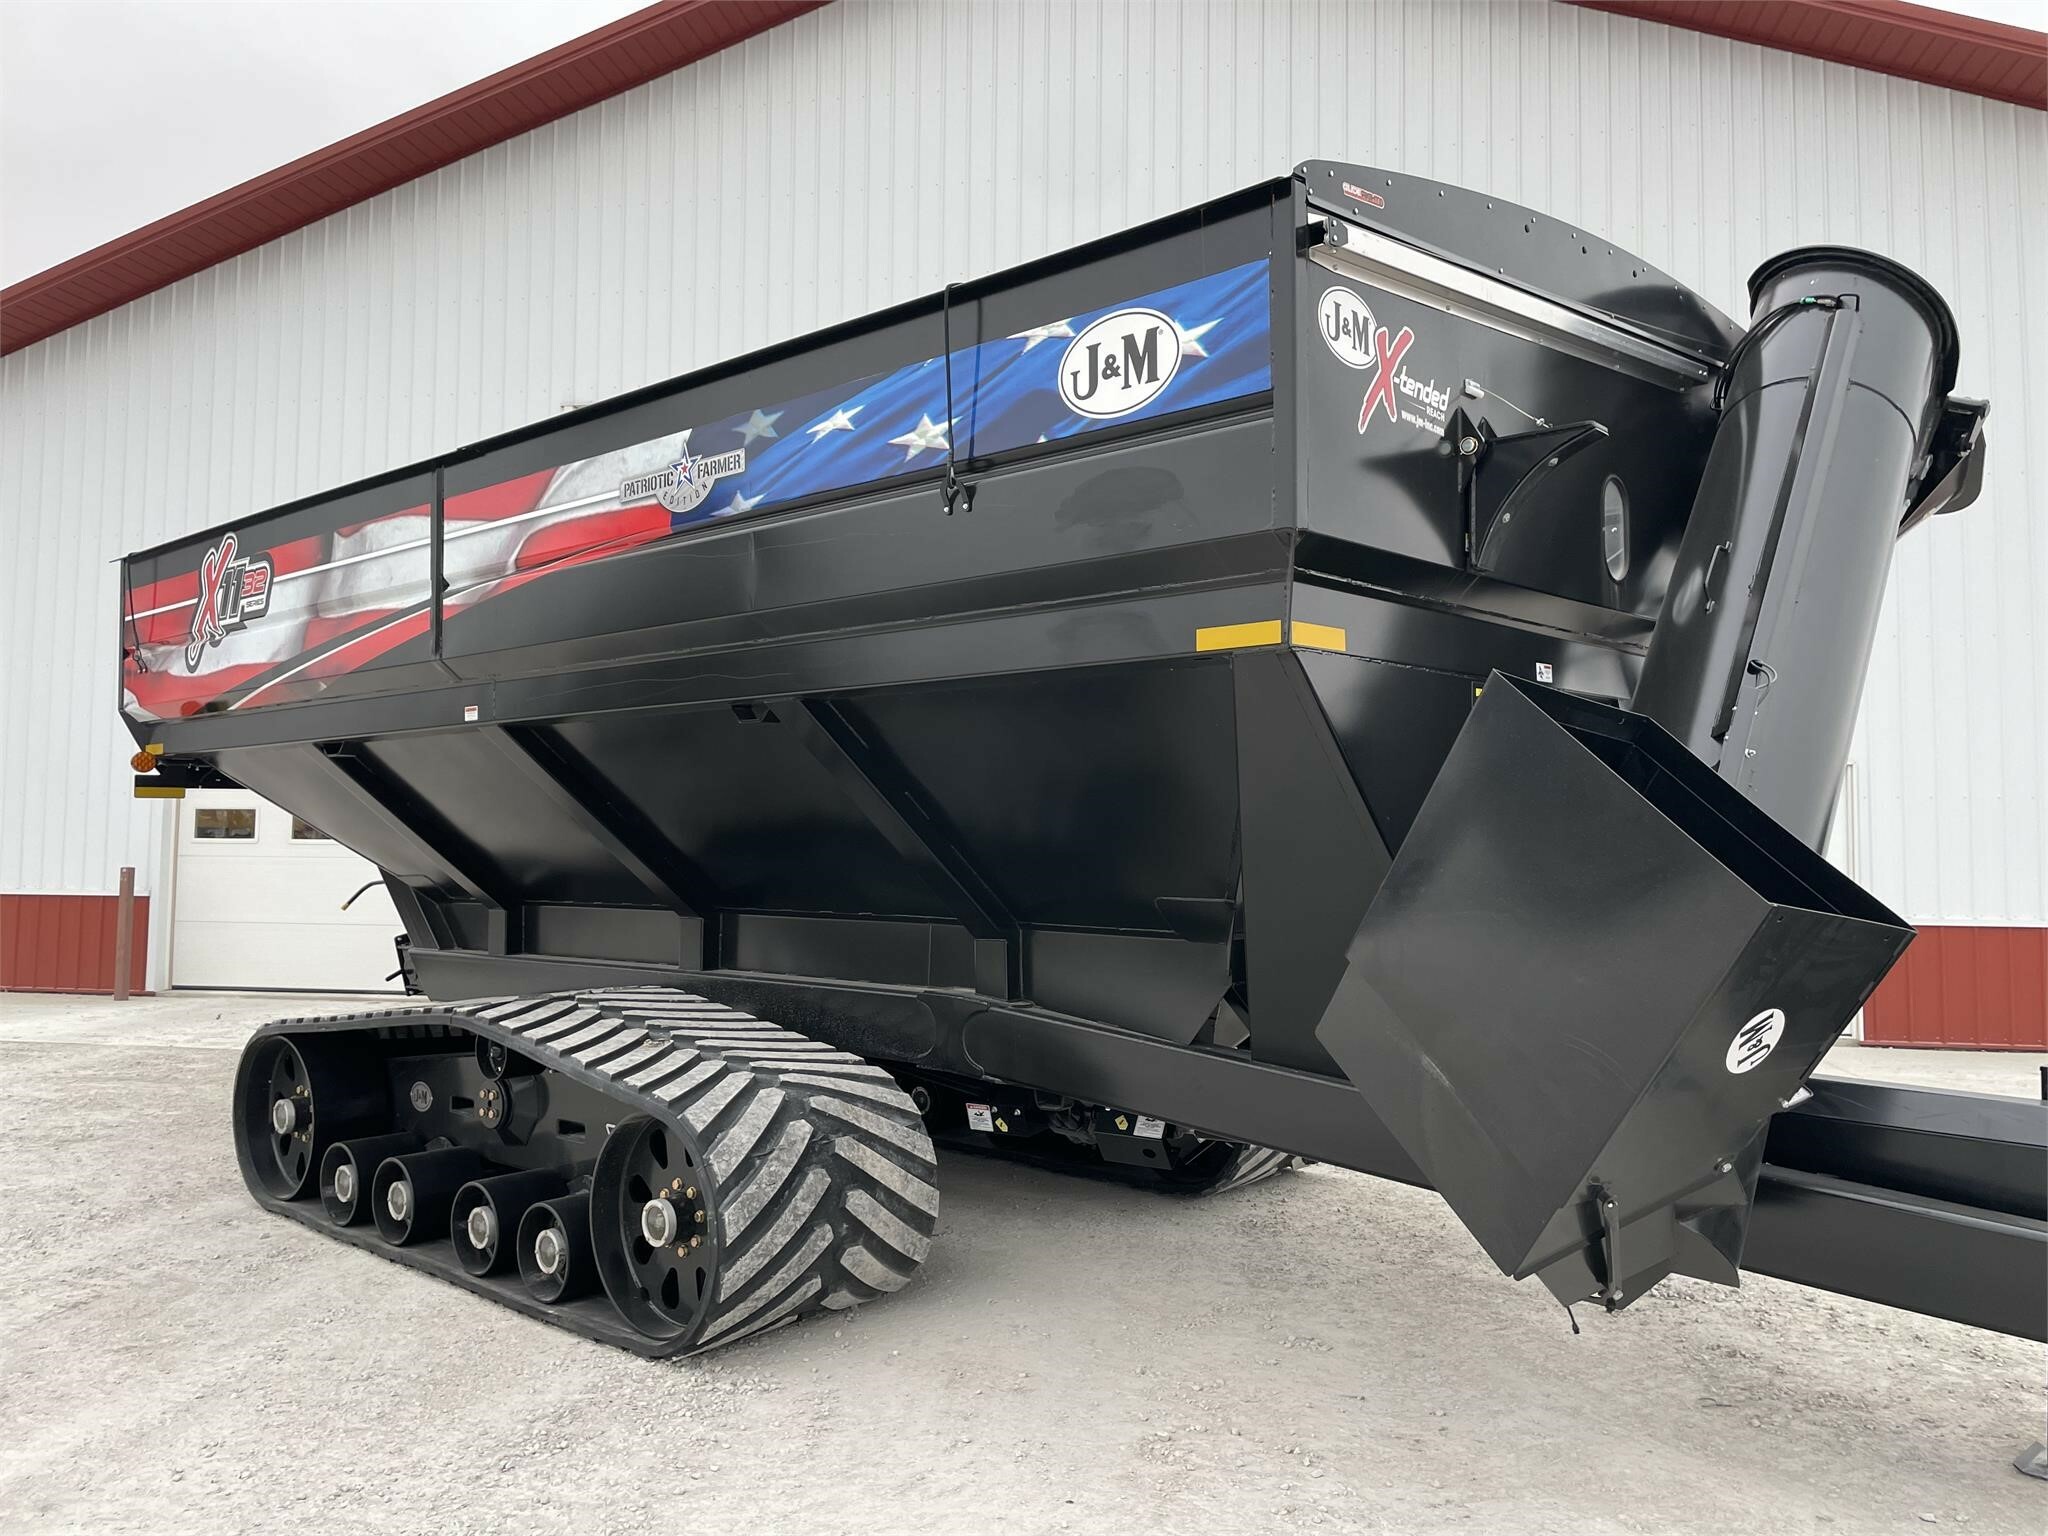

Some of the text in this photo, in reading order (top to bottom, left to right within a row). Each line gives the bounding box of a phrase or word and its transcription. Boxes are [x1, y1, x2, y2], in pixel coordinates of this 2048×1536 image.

[1325, 301, 1371, 357] J&M
[1070, 326, 1161, 401] J&M
[1426, 405, 1446, 422] REACH
[624, 454, 741, 498] PATRIOTIC FARMER
[662, 482, 708, 505] EDITION
[246, 598, 264, 608] SERIES
[1737, 1011, 1775, 1069] J&M
